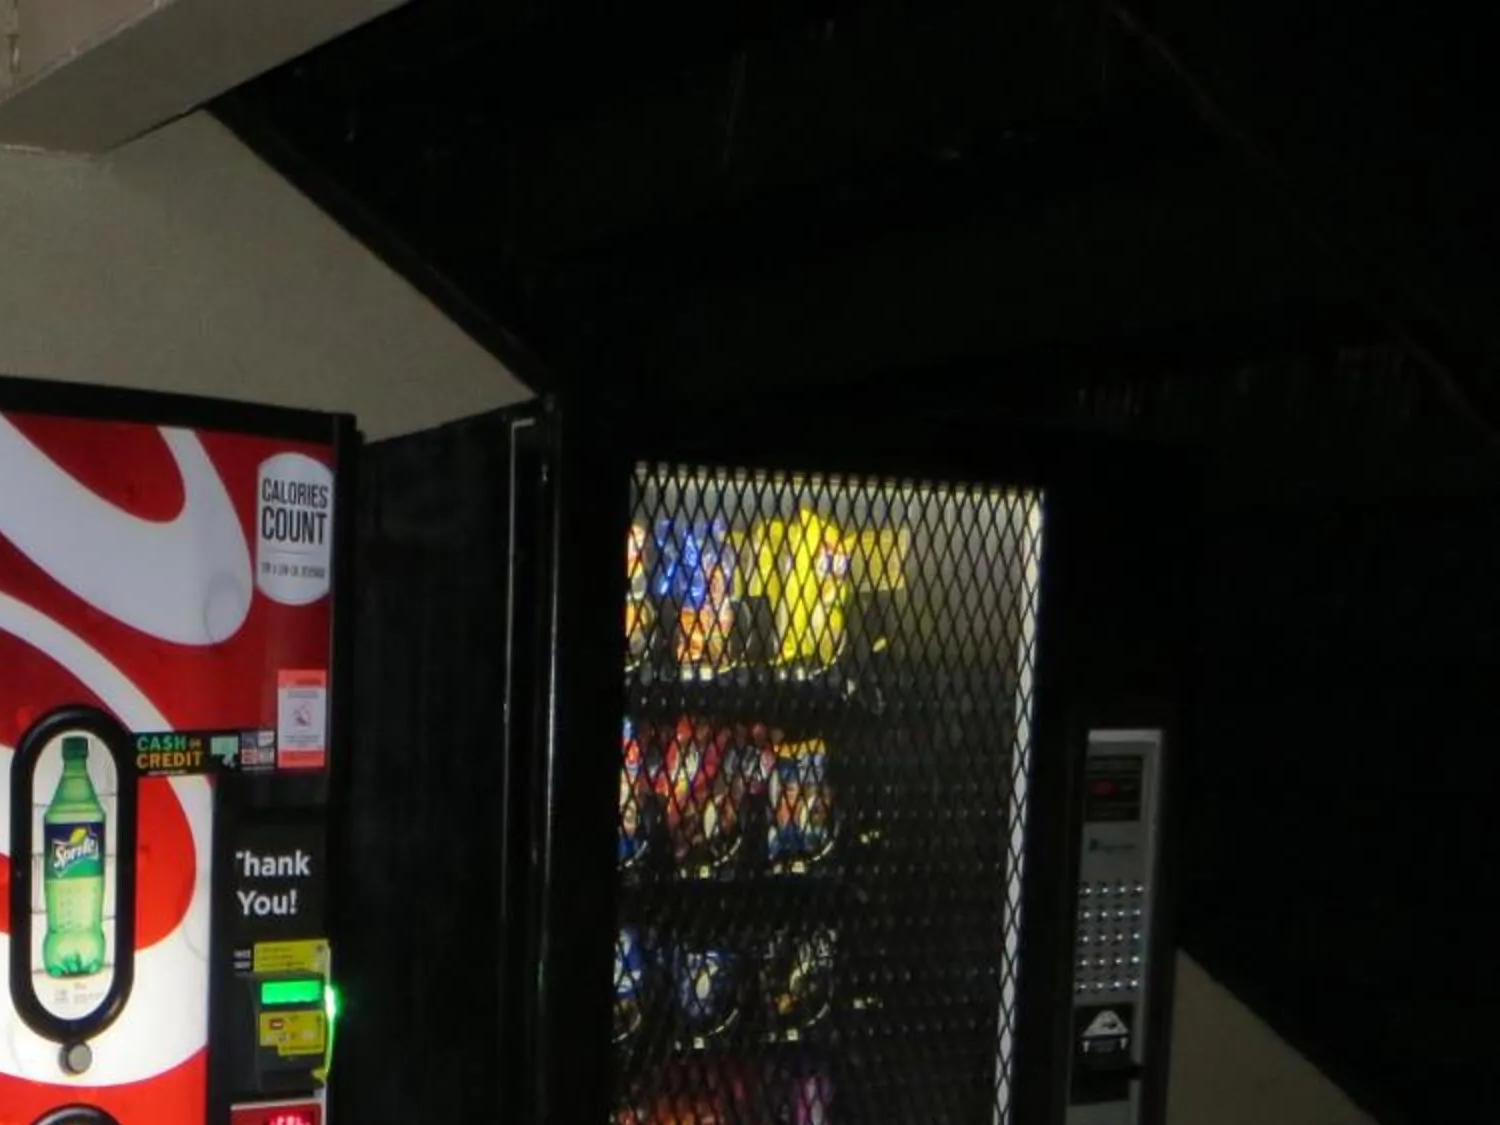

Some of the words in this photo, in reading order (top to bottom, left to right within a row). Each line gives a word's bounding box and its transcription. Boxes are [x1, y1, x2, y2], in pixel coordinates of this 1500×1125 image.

[261, 477, 329, 509] CALORIES
[261, 506, 328, 546] COUNT
[137, 735, 186, 752] CASH
[136, 751, 202, 770] CREDIT
[52, 834, 100, 869] Sprite
[235, 849, 311, 877] hank
[236, 889, 298, 916] You!
